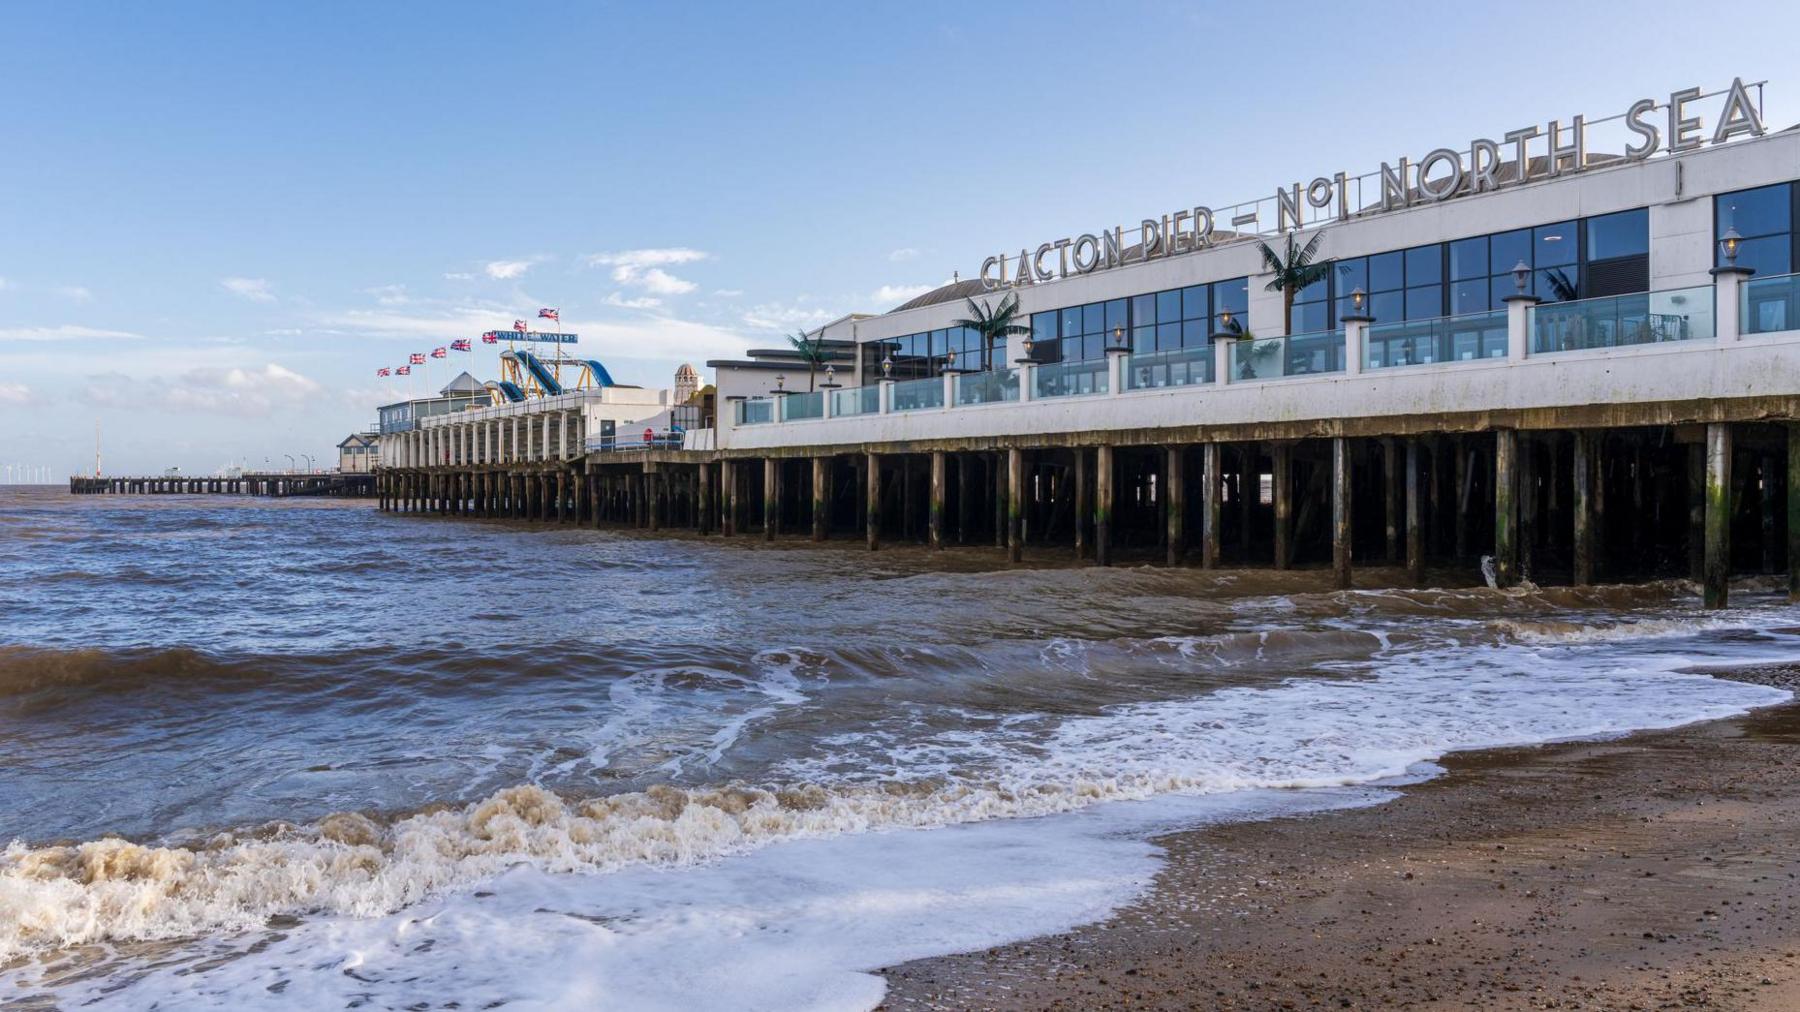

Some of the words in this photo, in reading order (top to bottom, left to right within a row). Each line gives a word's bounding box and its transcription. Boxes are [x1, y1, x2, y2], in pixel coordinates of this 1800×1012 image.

[980, 226, 1122, 290] CLACTON
[1142, 206, 1214, 262] PIER
[1380, 114, 1585, 212] NORTH
[1625, 77, 1765, 160] SEA
[540, 333, 577, 343] WATER
